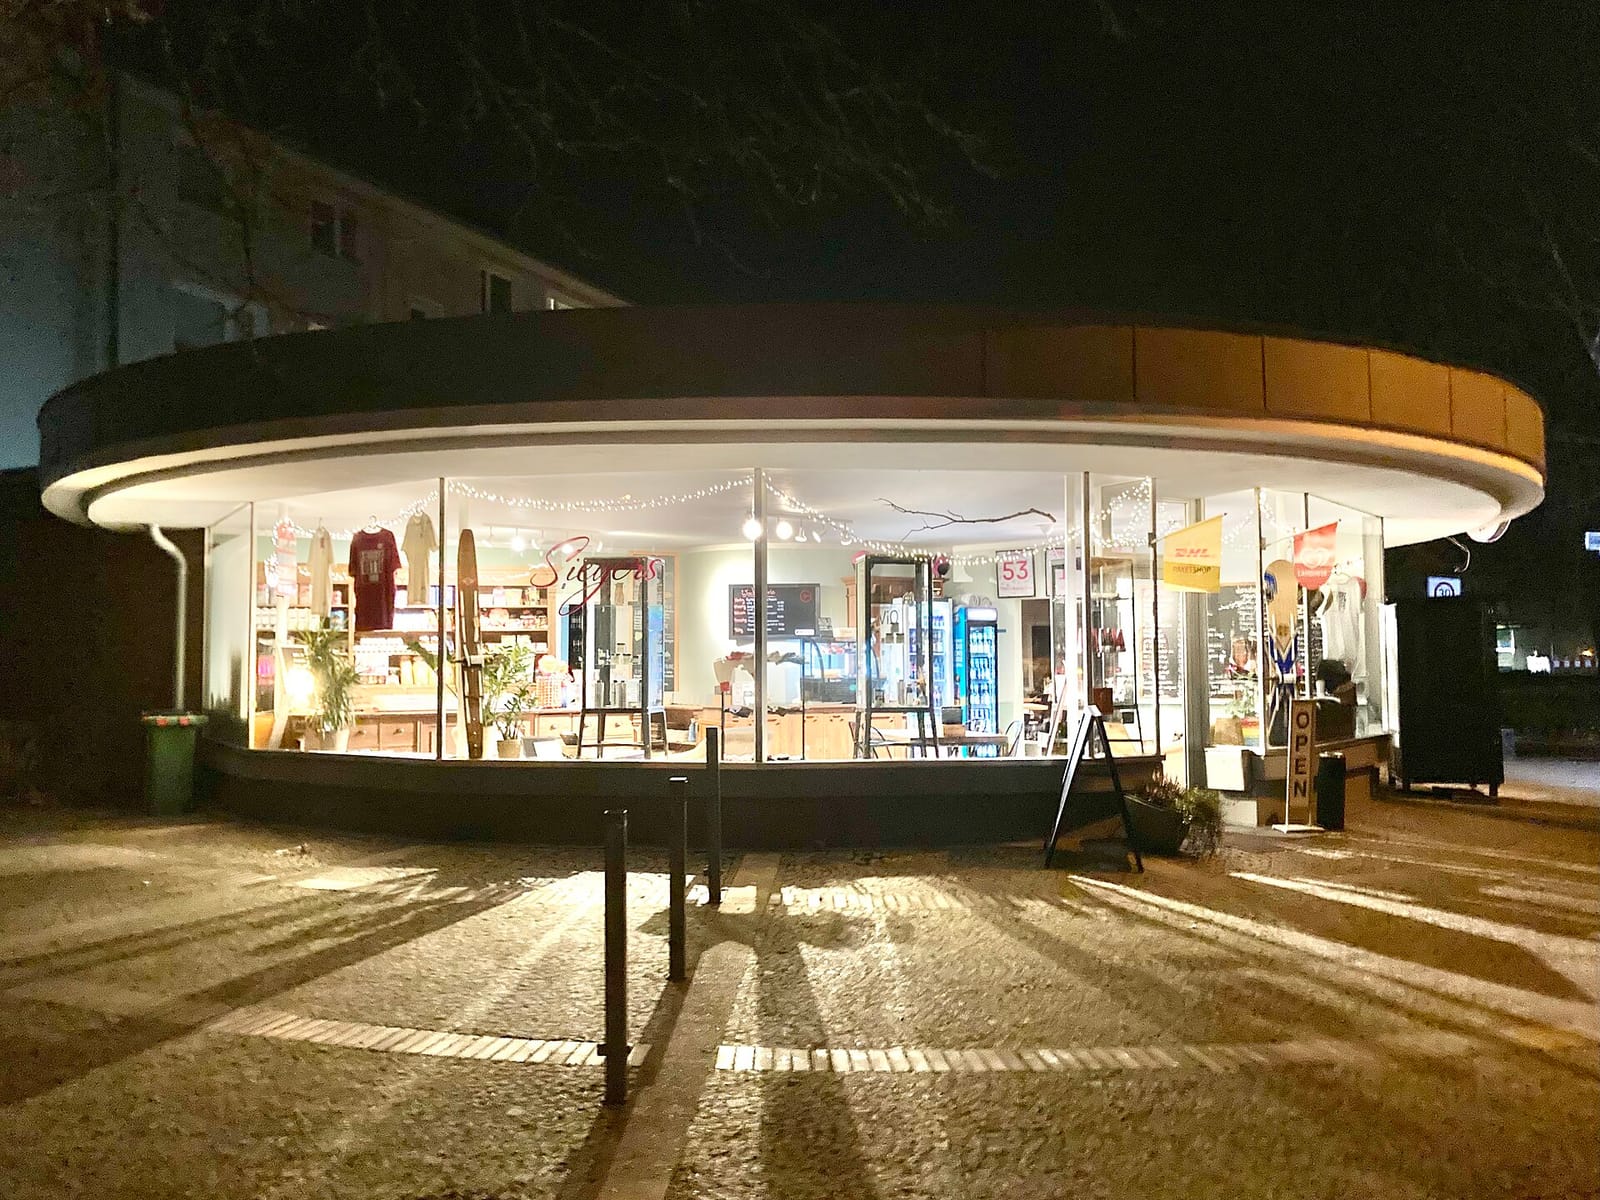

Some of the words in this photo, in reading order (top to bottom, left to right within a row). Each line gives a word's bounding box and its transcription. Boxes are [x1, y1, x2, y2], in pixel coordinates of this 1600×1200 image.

[1175, 548, 1211, 558] DHL
[1003, 560, 1028, 580] 53
[1294, 711, 1310, 797] OPEN
